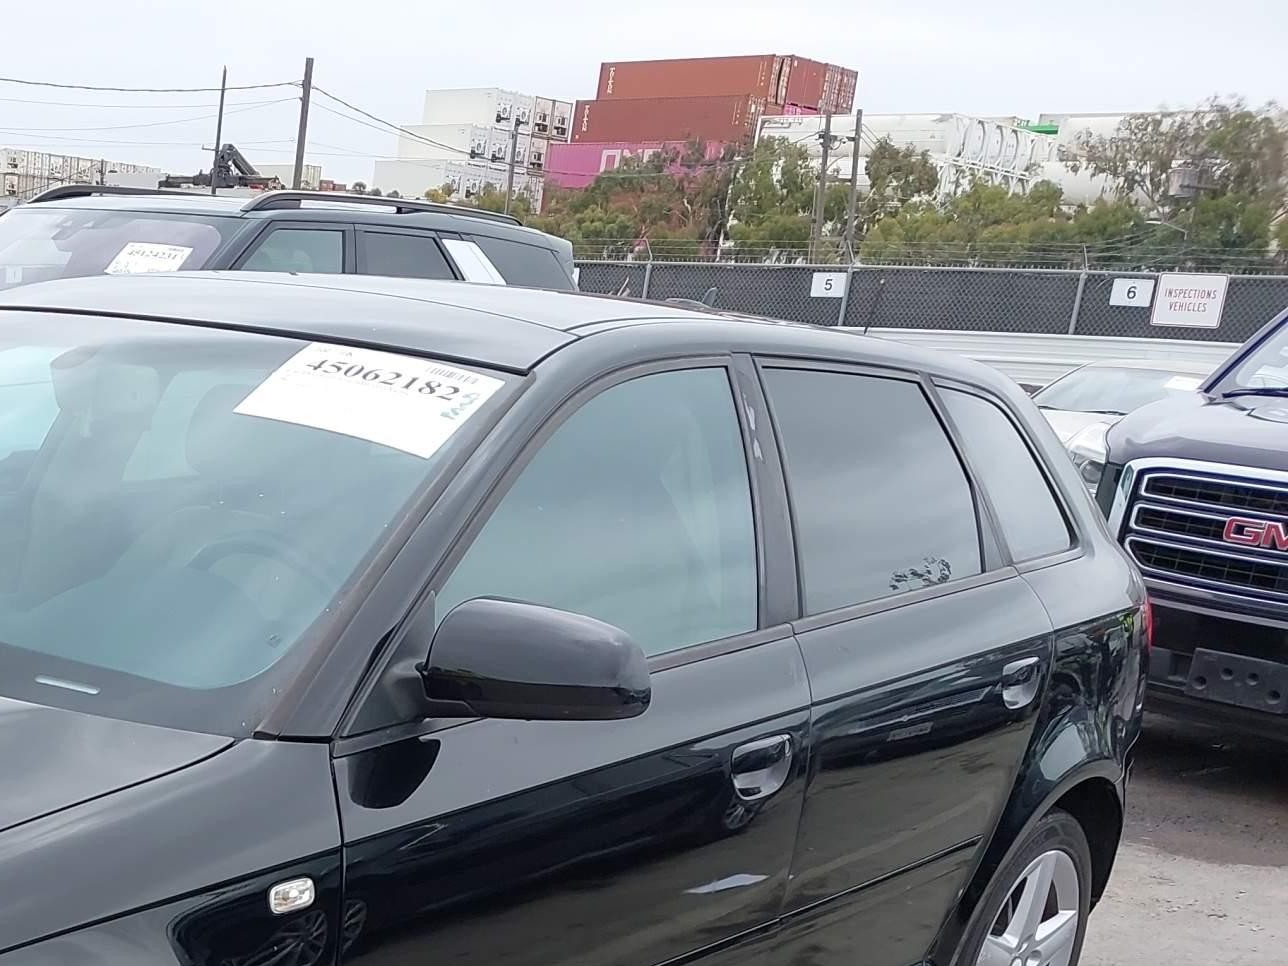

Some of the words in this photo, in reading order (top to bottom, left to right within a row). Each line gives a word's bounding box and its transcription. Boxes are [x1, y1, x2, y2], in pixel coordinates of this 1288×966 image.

[824, 278, 833, 291] 5
[1126, 286, 1137, 300] 6
[1164, 287, 1218, 300] INSPECTIONS
[1169, 301, 1208, 313] VEHICLES
[306, 358, 461, 401] 45062182
